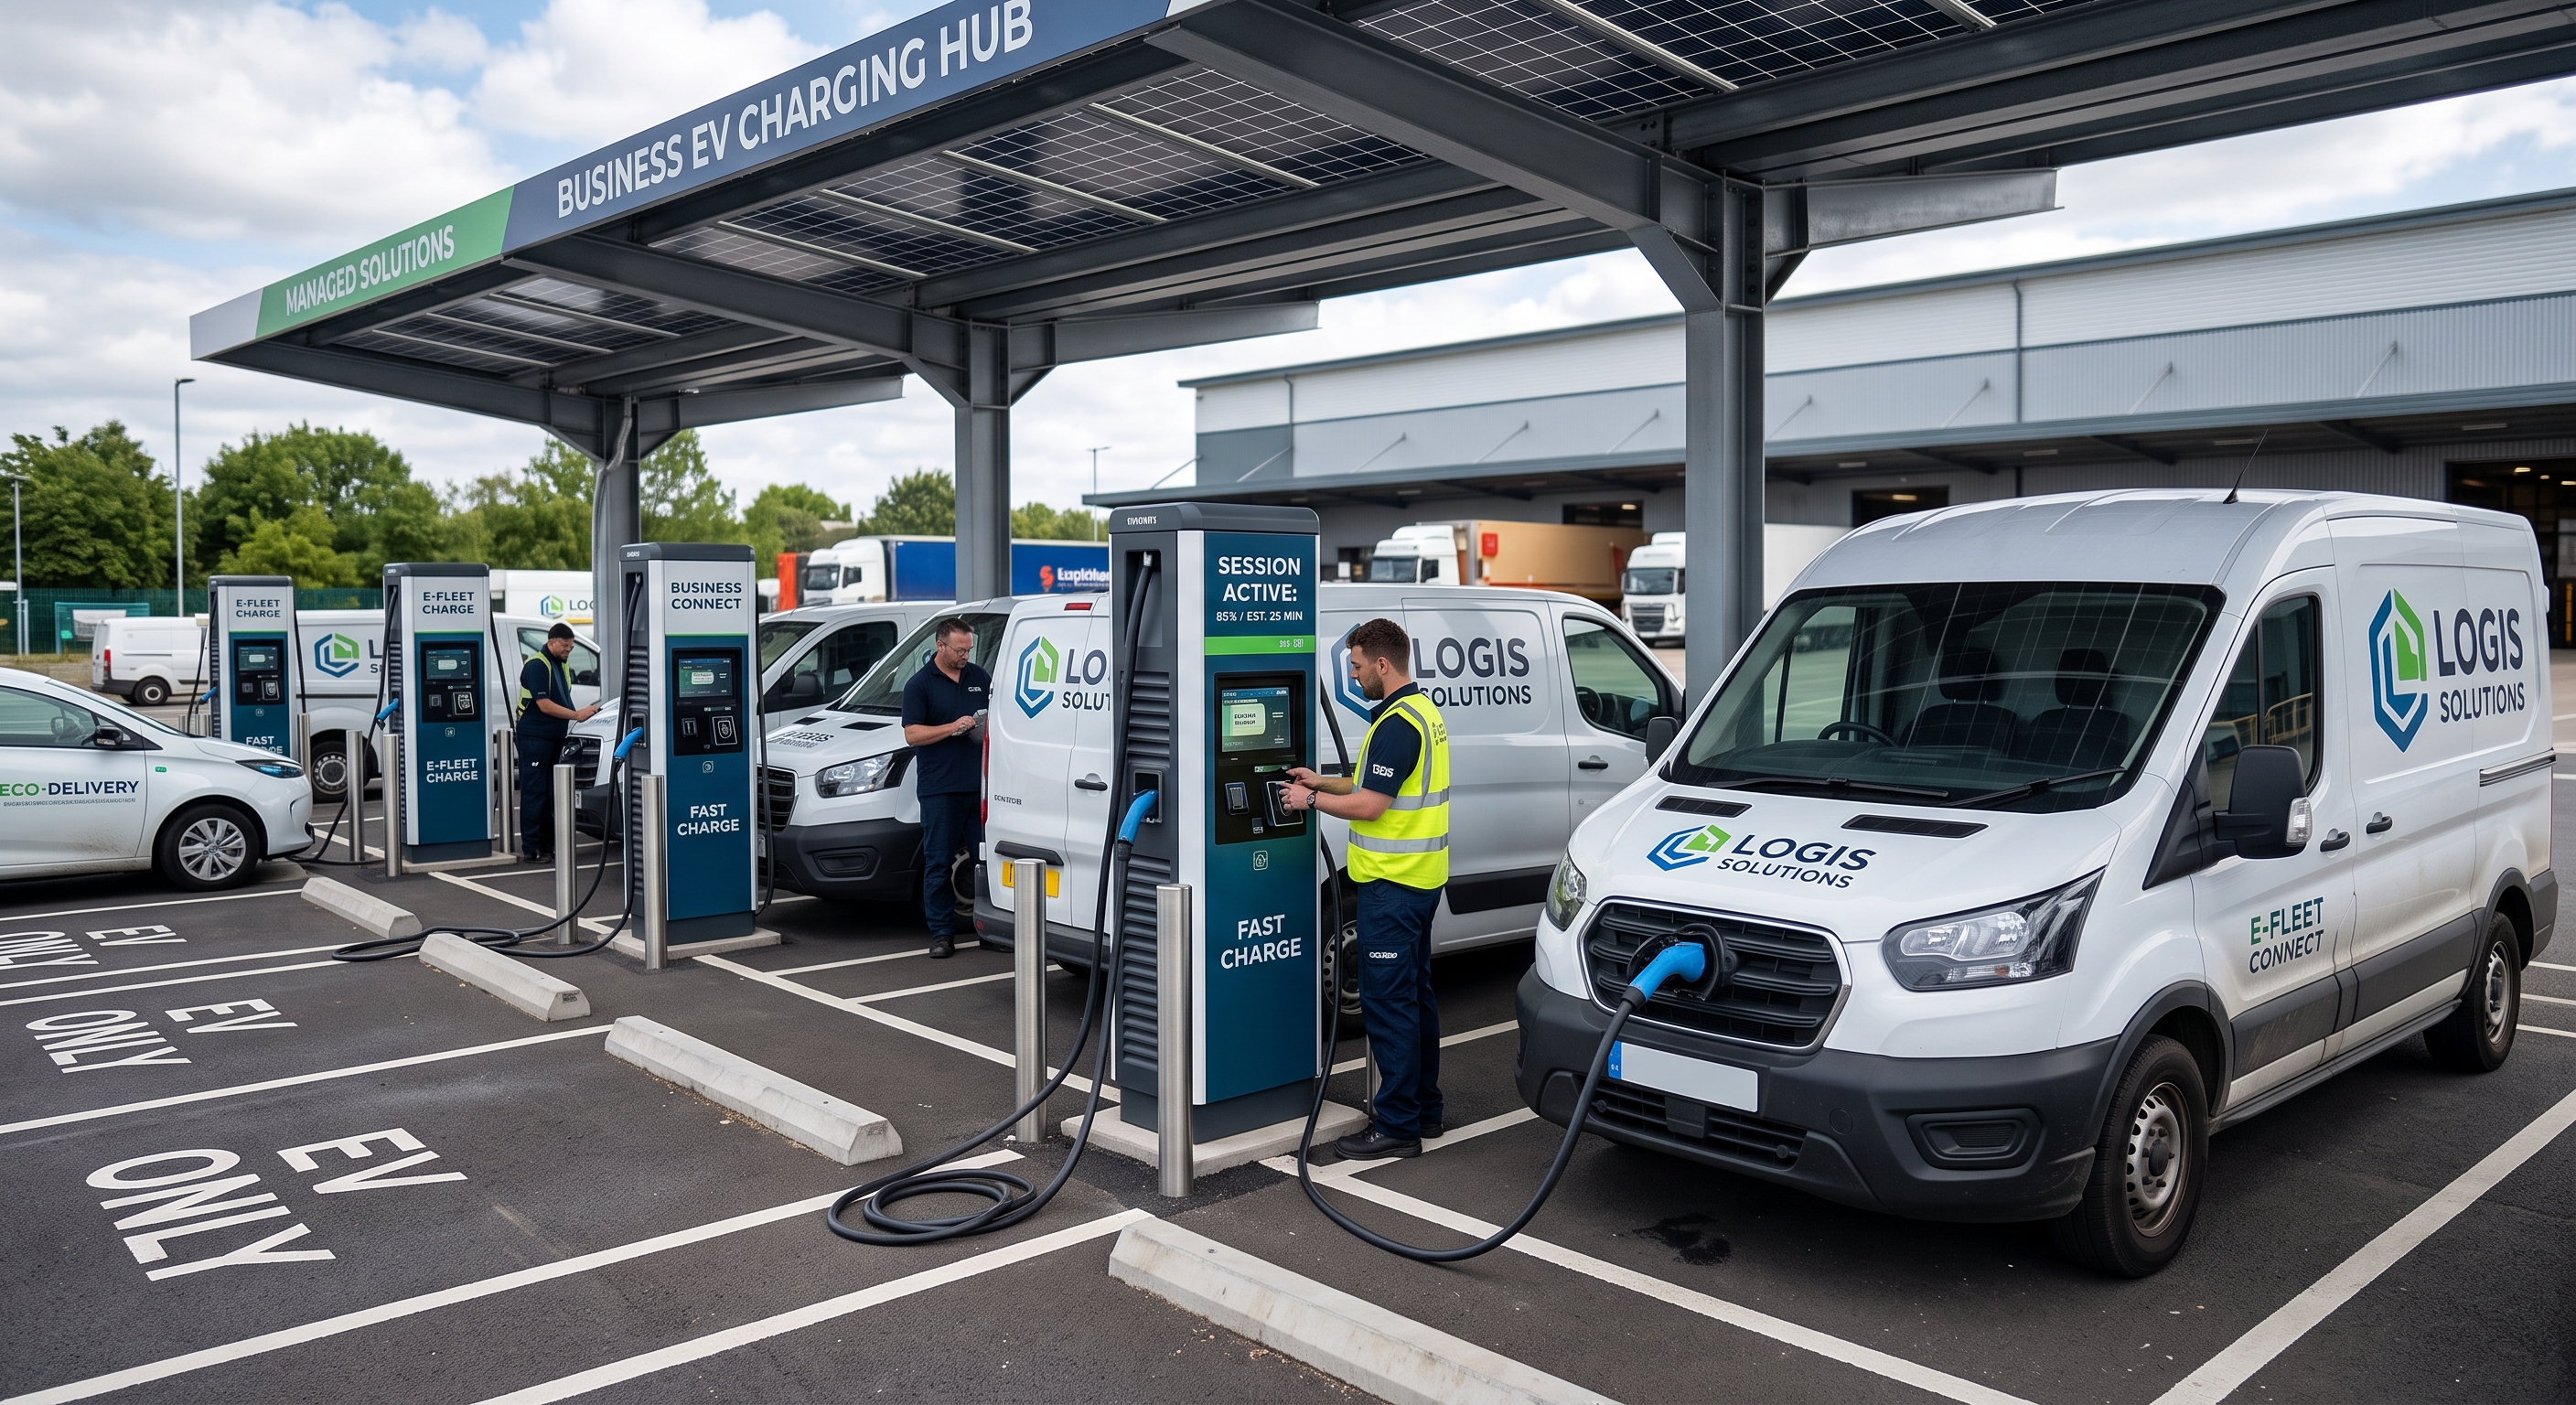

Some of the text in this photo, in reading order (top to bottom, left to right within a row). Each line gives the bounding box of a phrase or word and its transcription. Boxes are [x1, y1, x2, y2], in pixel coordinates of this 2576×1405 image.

[558, 0, 1034, 220] BUSINESS EV CHARGING HUB
[286, 224, 455, 316] MANAGED SOLUTIONS
[1218, 556, 1301, 576] SESSION
[423, 592, 475, 602] E-FLEET
[671, 582, 742, 594] BUSINESS
[1222, 583, 1297, 602] ACTIVE:
[236, 599, 281, 607] E-FLEET
[236, 609, 281, 618] CHARGE
[422, 605, 475, 615] CHARGE
[671, 598, 742, 610] CONNECT
[1216, 611, 1238, 622] 85%
[1247, 611, 1267, 621] EST.
[1269, 611, 1282, 621] 25
[1283, 611, 1303, 621] MIN
[2432, 607, 2524, 677] LOGIS
[1412, 638, 1530, 679] LOGIS
[2440, 683, 2526, 724] SOLUTIONS
[246, 736, 274, 746] FAST
[426, 758, 478, 771] E-FLEET
[425, 771, 478, 783] CHARGE
[690, 803, 727, 819] FAST
[677, 819, 740, 836] CHARGE
[1731, 834, 1877, 871] LOGIS
[1716, 858, 1854, 889] SOLUTIONS
[1238, 914, 1285, 940] FAST
[2250, 896, 2324, 945] E-FLEET
[85, 925, 188, 946] EV
[1220, 937, 1302, 970] CHARGE
[2249, 930, 2324, 974] CONNECT
[165, 999, 298, 1033] EV
[26, 1010, 191, 1073] ONLY
[276, 1128, 468, 1194] EV
[86, 1149, 336, 1281] ONLY
